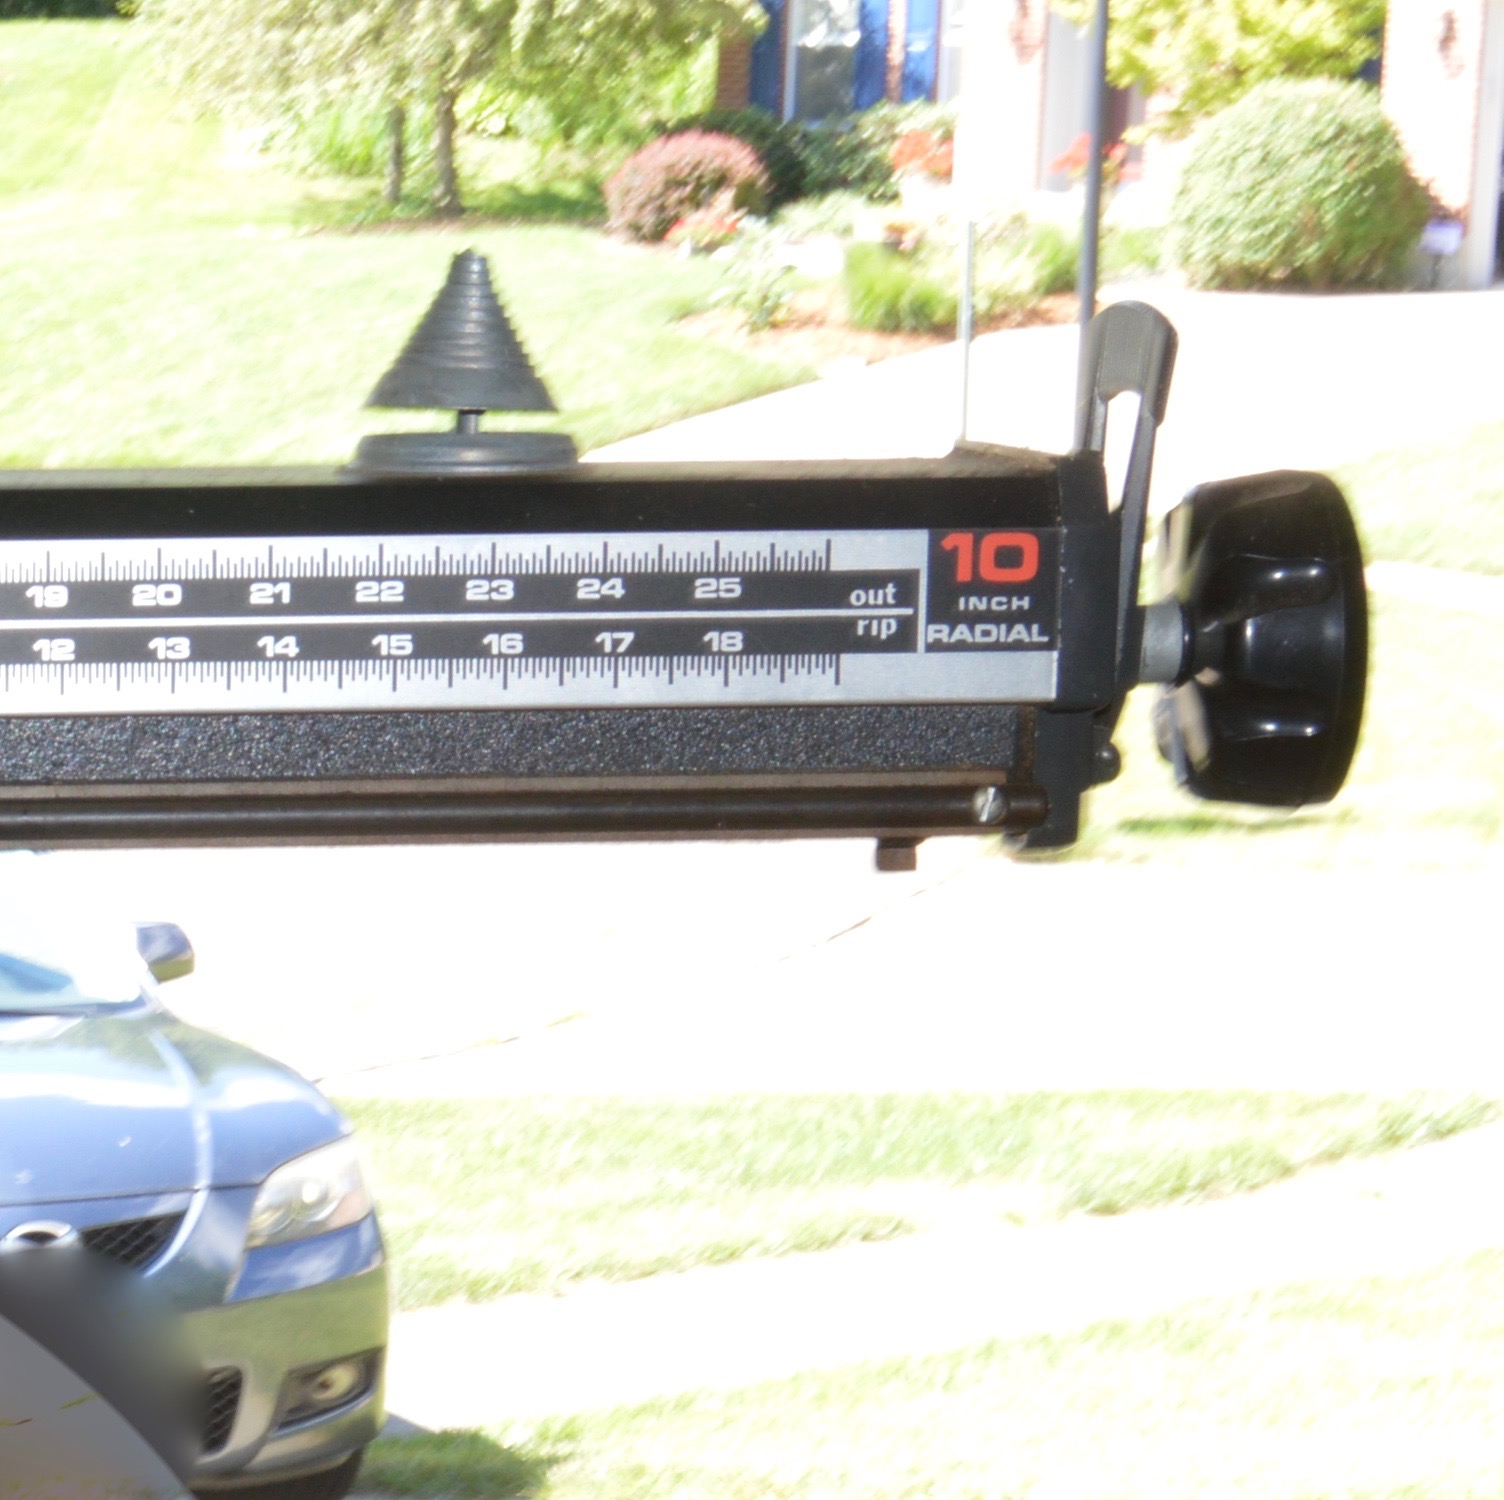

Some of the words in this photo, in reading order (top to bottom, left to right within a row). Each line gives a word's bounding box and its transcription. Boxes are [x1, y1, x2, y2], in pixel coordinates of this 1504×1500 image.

[940, 532, 1039, 583] 10
[24, 584, 69, 609] 19
[131, 583, 183, 607] 20
[249, 581, 291, 605] 21
[355, 580, 405, 603] 22
[465, 579, 515, 601] 23
[576, 578, 626, 600] 24
[693, 577, 742, 599] 25
[849, 584, 896, 607] out
[957, 596, 1031, 612] INCH
[31, 638, 76, 662] 12
[147, 636, 191, 660] 13
[256, 635, 300, 658] 14
[371, 634, 413, 657] 15
[482, 633, 524, 655] 16
[595, 632, 634, 653] 17
[703, 631, 743, 652] 18
[855, 615, 898, 641] rip
[927, 622, 1050, 644] RADIAL
